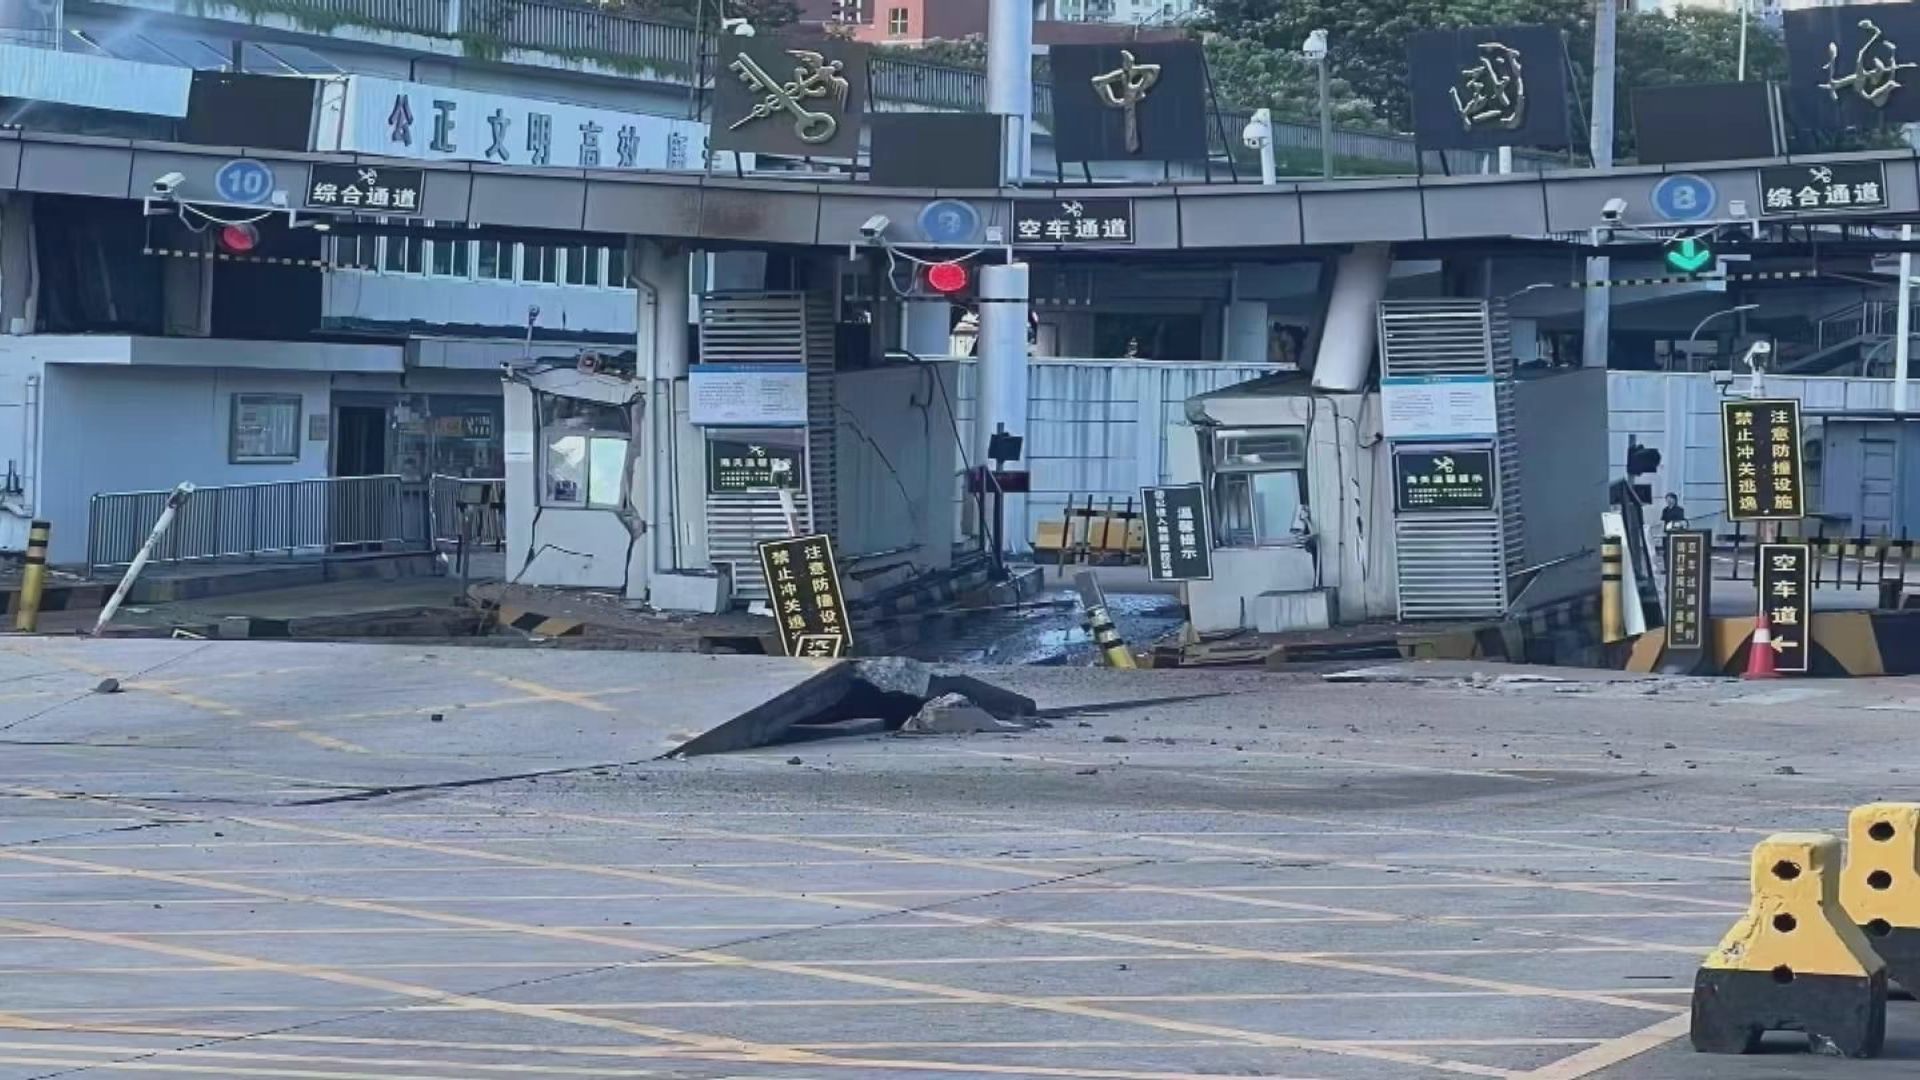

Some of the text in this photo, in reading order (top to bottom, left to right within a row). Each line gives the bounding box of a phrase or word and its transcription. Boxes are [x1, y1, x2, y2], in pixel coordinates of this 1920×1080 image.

[1091, 50, 1161, 154] 中
[228, 170, 263, 194] 10
[312, 182, 417, 208] 综合通道
[1766, 181, 1881, 208] 综合通道
[1018, 217, 1127, 240] 空车通道
[1770, 409, 1793, 510] 注意防撞设施
[1771, 554, 1798, 625] 空车道
